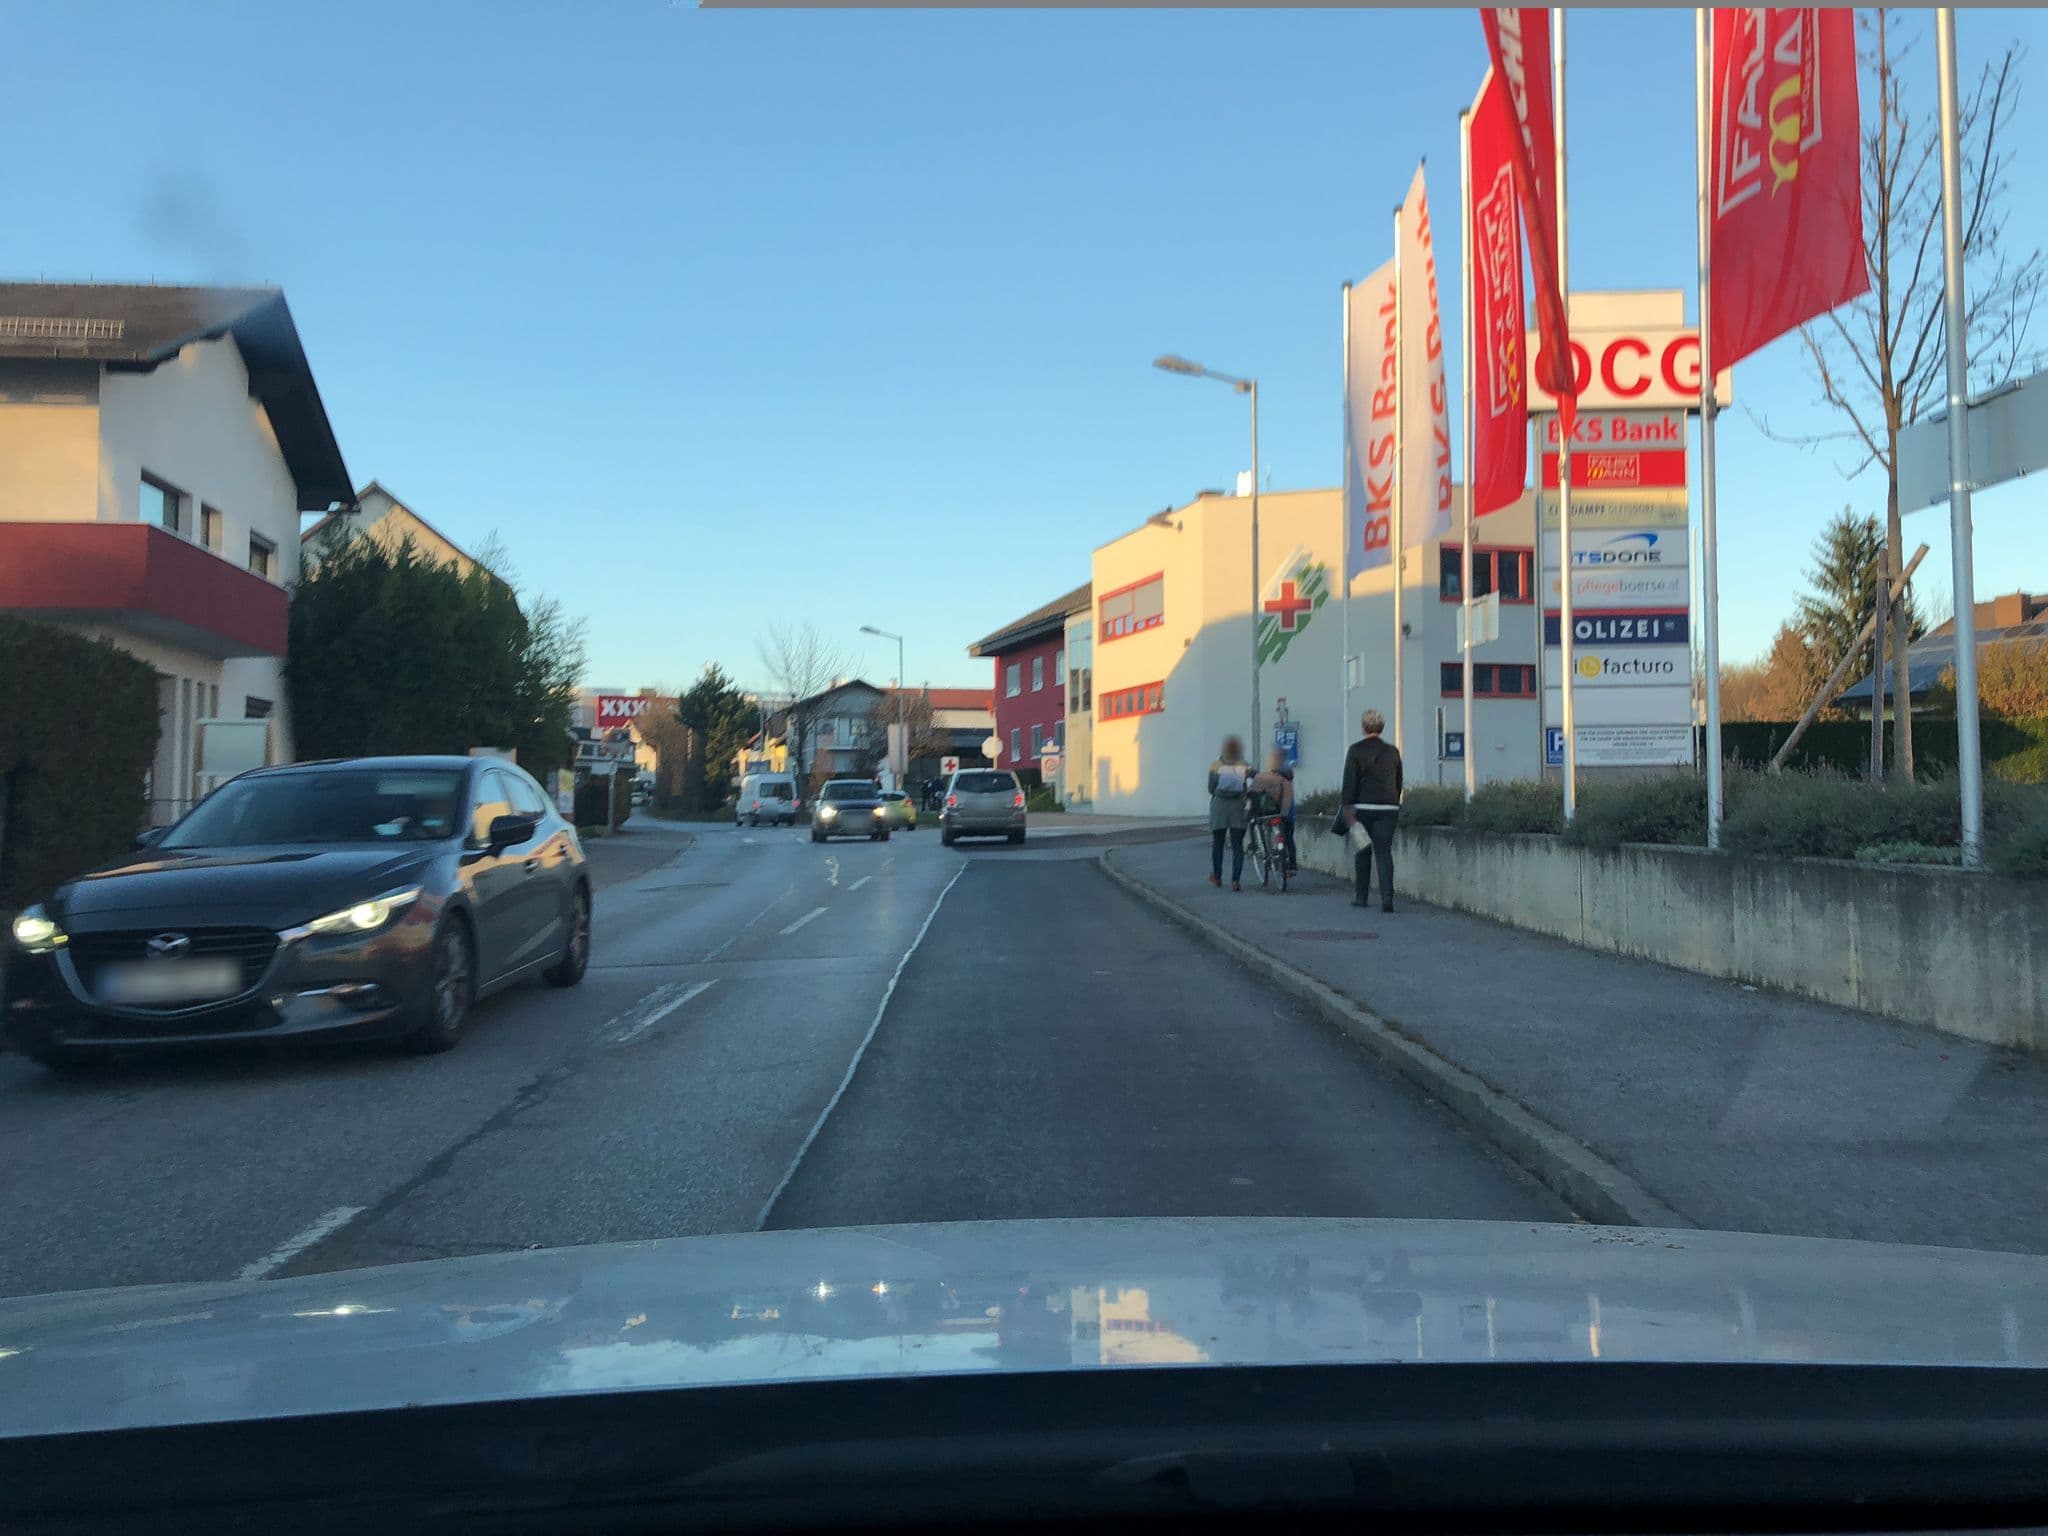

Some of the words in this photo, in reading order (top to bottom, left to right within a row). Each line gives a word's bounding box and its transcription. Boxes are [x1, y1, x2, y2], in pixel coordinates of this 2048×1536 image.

[1371, 280, 1397, 422] Bank
[1611, 413, 1679, 442] Bank
[1363, 432, 1396, 552] BKS
[1574, 618, 1660, 640] OLIZEI
[1602, 655, 1674, 675] facturo
